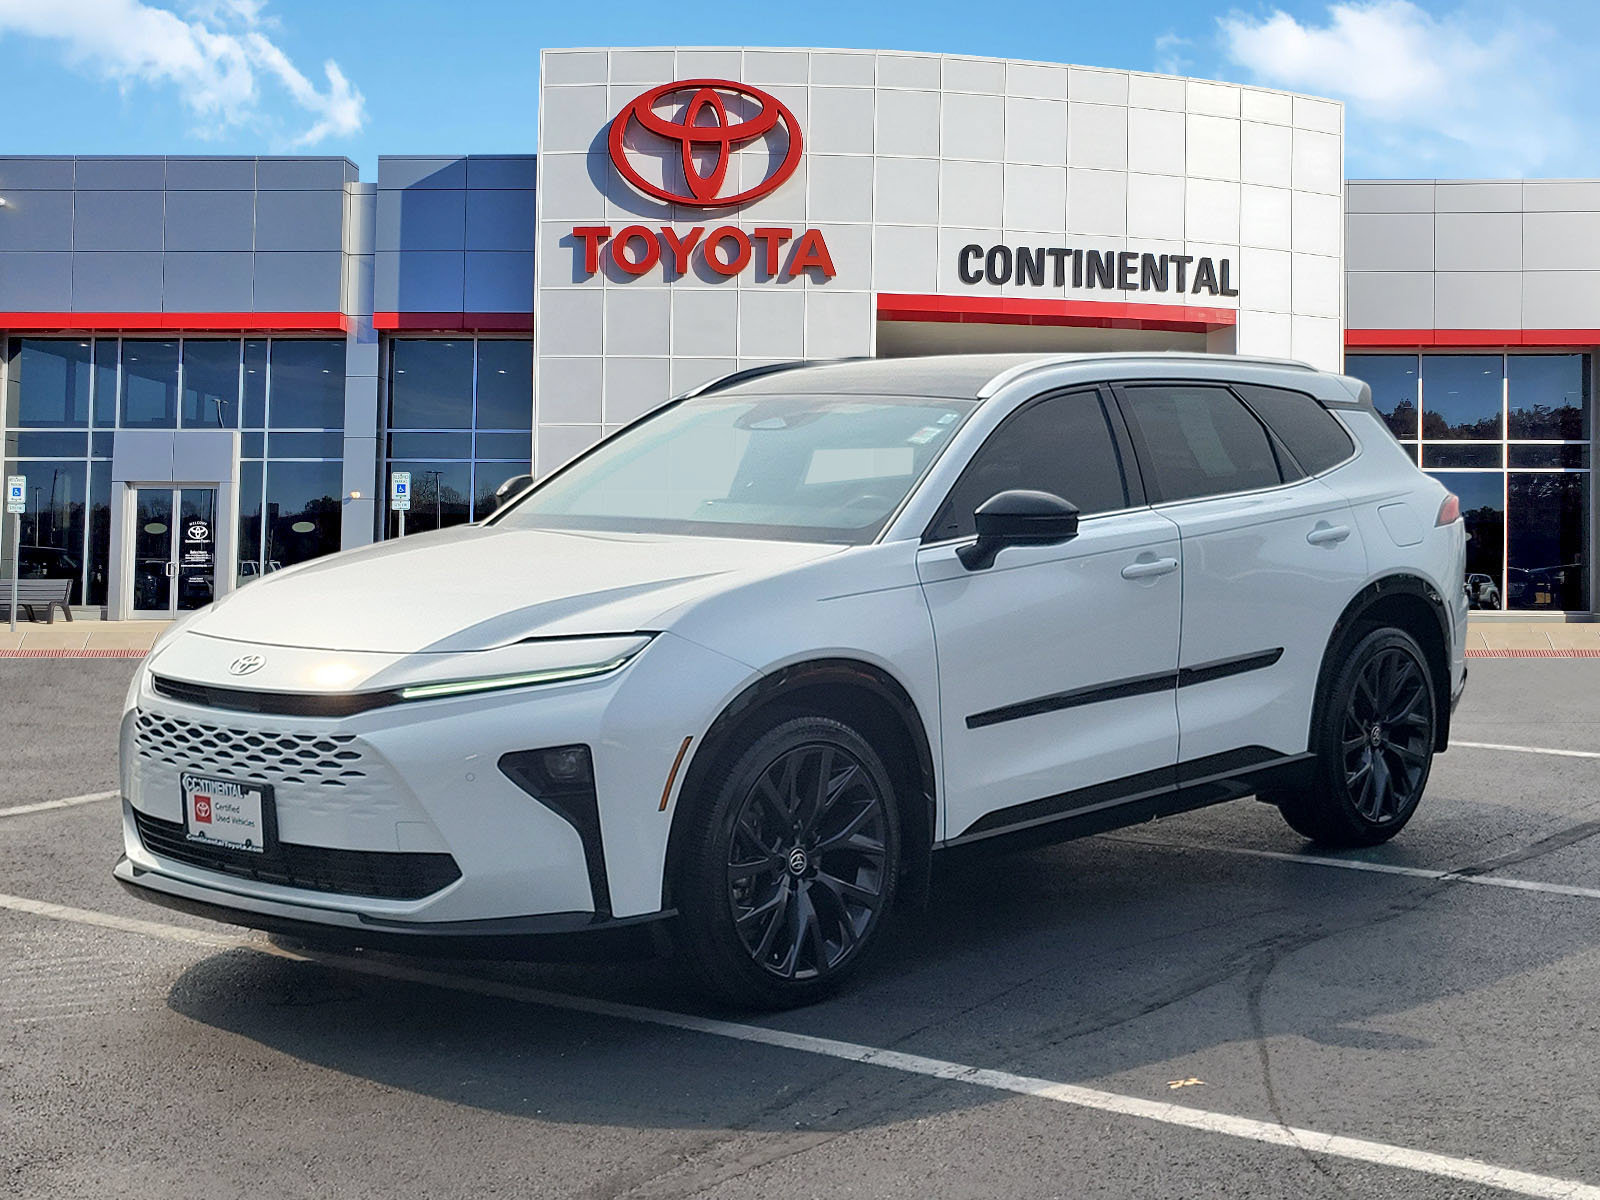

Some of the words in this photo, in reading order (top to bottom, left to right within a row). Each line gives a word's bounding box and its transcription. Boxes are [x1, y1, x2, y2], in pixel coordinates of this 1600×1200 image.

[572, 225, 837, 277] TOYOTA
[958, 244, 1239, 297] CONTINENTAL
[215, 802, 240, 814] Certified
[215, 814, 231, 824] Used
